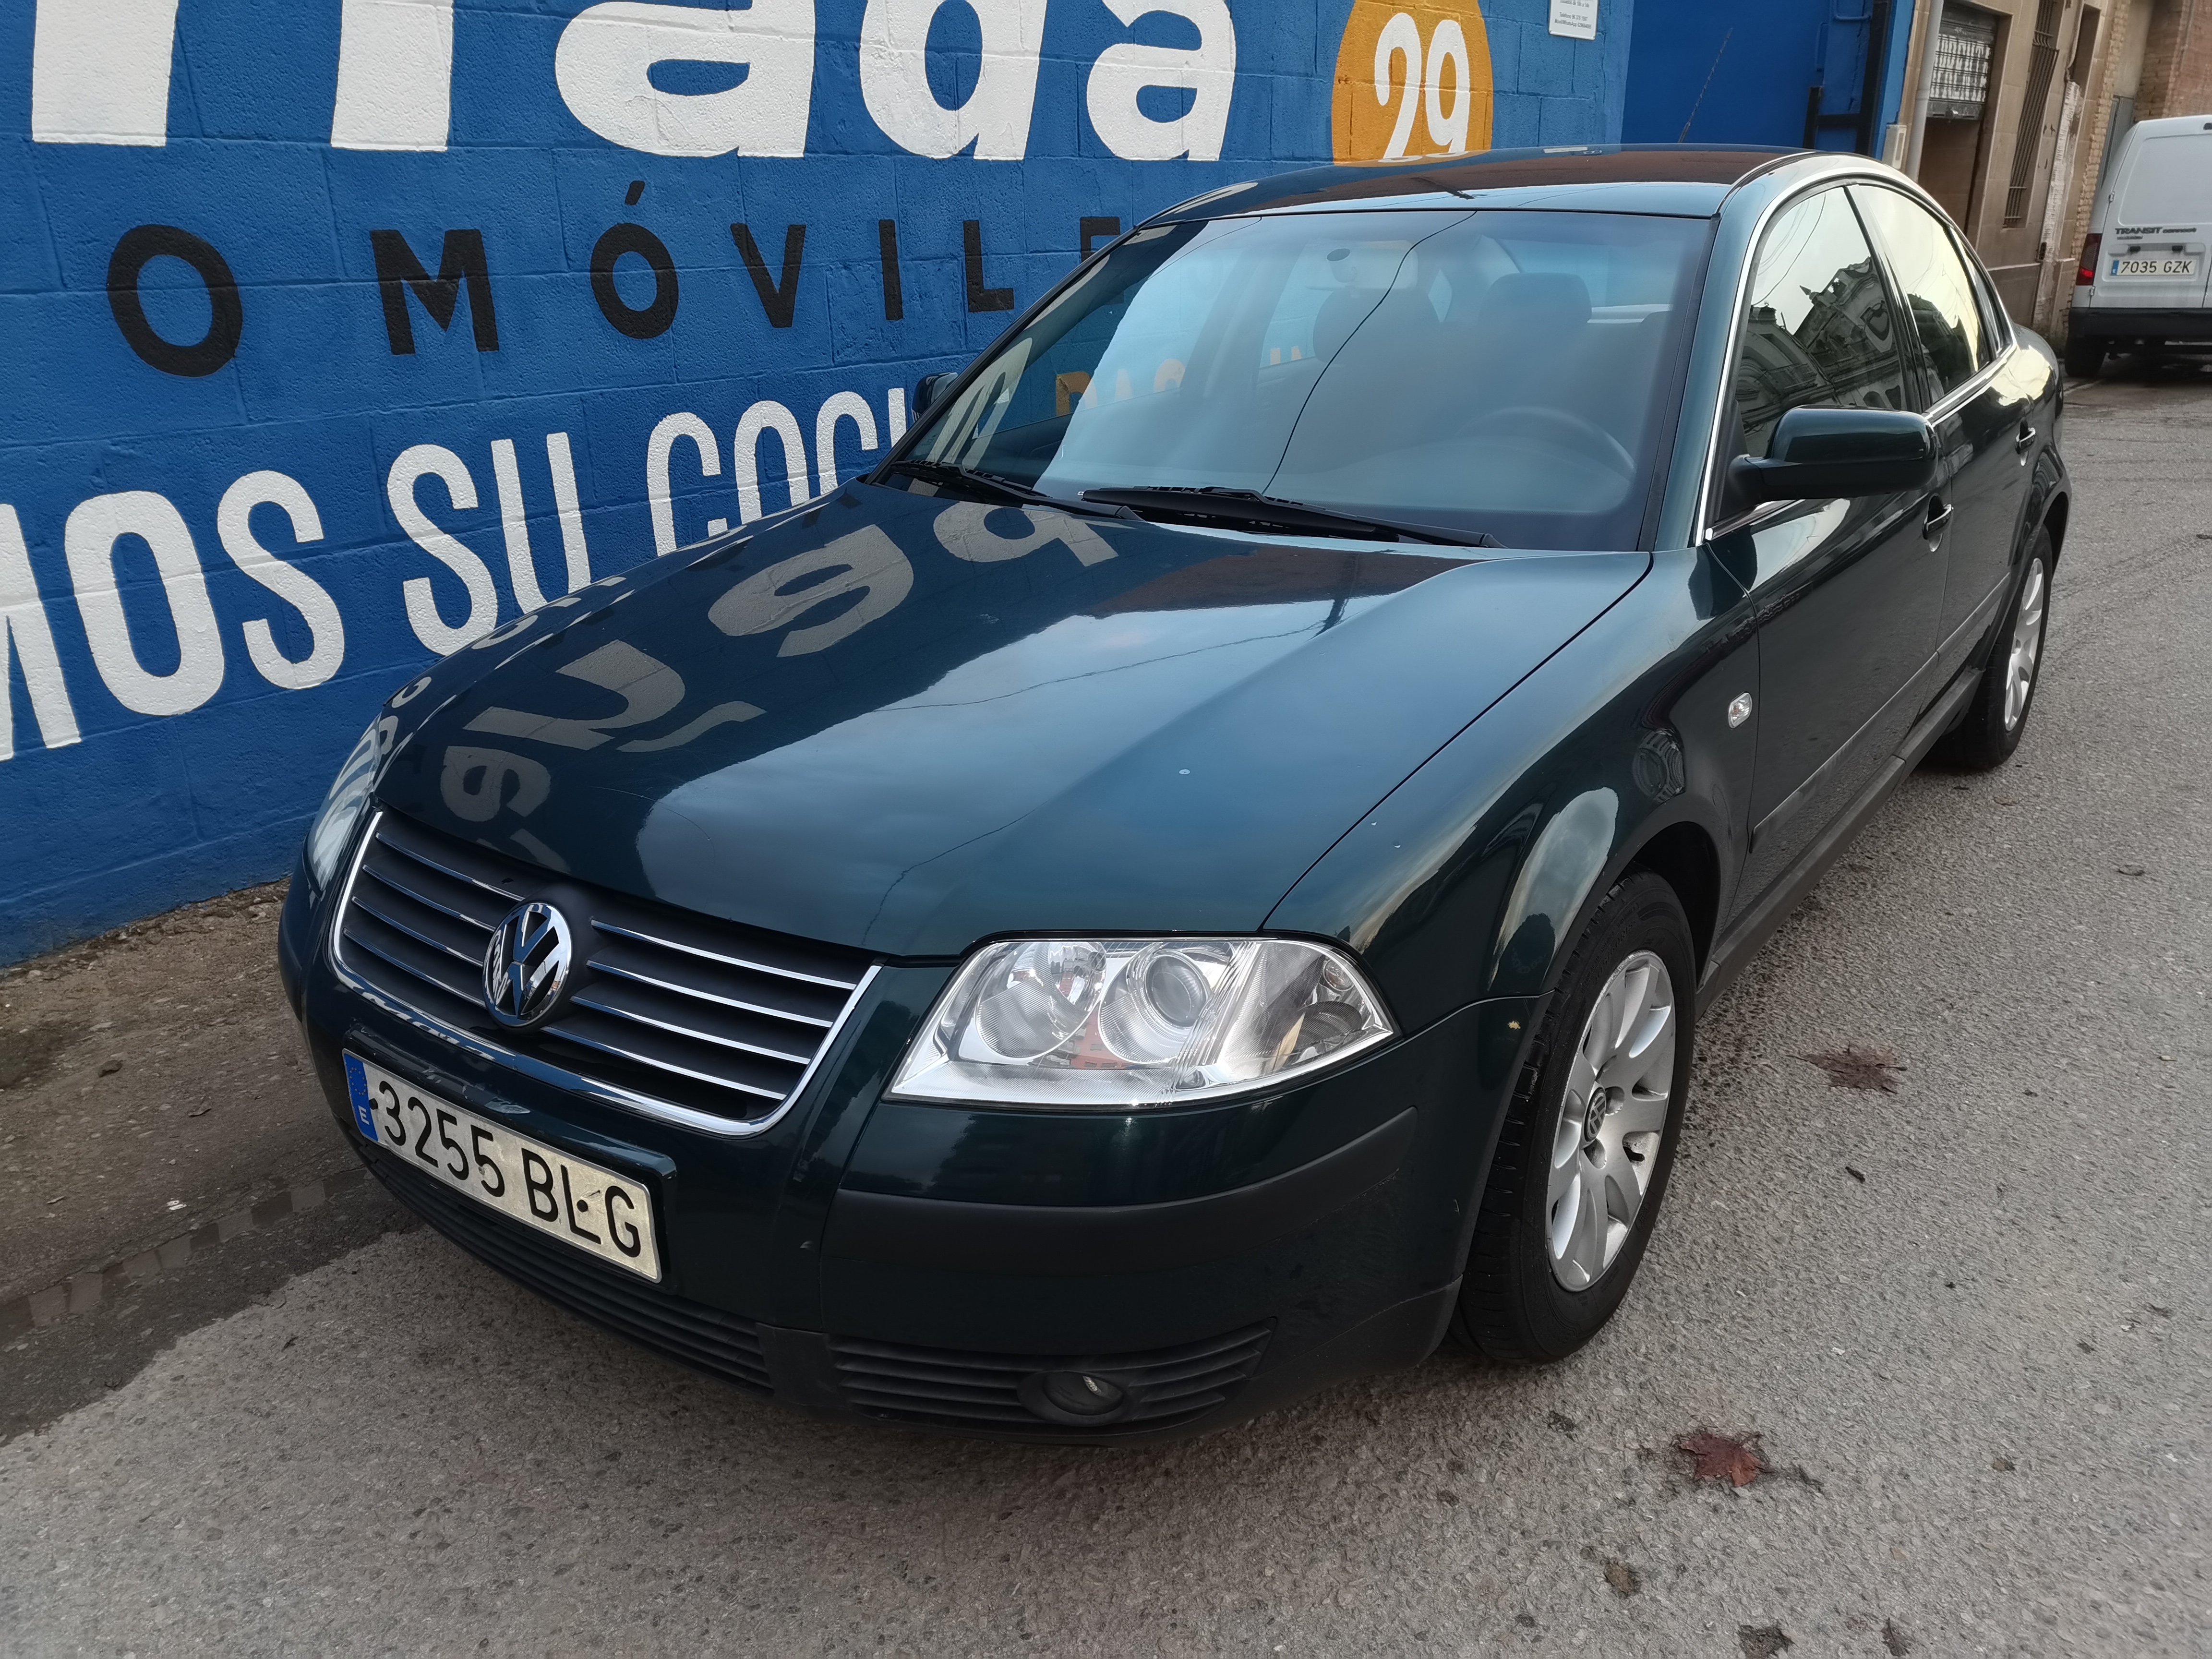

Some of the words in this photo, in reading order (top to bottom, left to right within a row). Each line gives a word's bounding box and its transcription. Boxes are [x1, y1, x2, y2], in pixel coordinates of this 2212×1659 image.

[2121, 261, 2157, 274] 7035
[2163, 261, 2192, 274] GZK
[387, 432, 591, 657] SU
[358, 1105, 370, 1126] E
[378, 1080, 505, 1198] 3255
[521, 1148, 641, 1258] BLG
